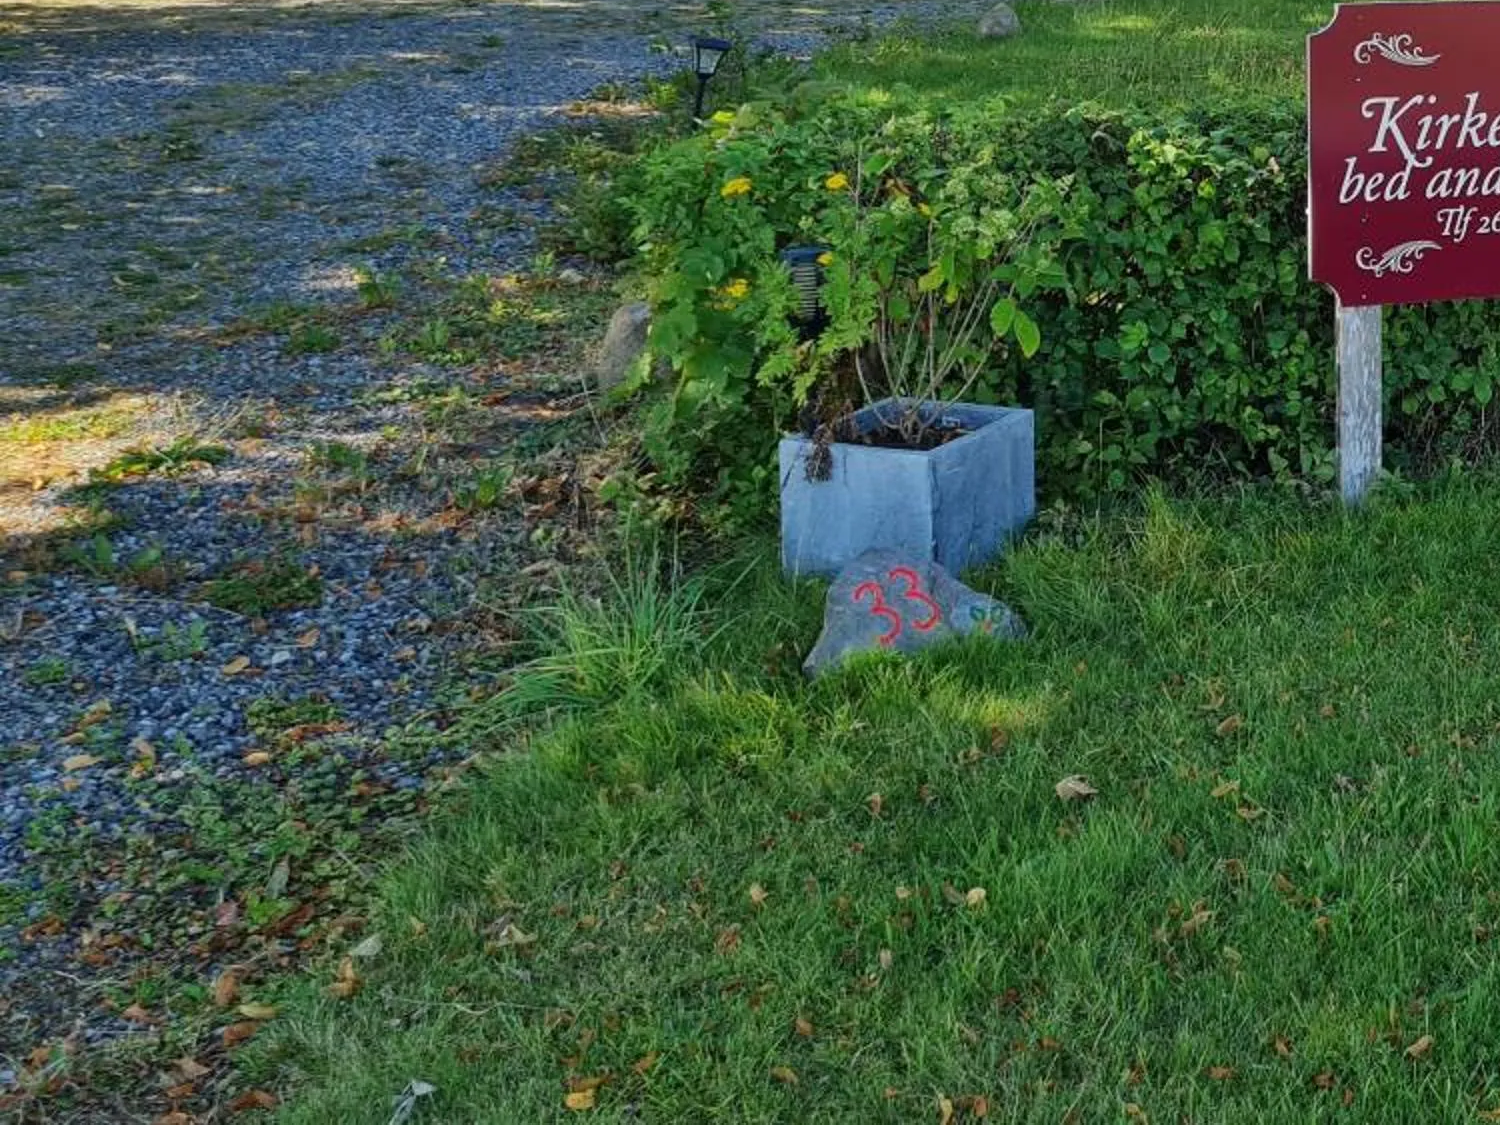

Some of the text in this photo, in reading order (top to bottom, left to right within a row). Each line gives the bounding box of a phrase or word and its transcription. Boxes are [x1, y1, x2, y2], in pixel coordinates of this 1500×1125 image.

[1339, 154, 1414, 204] bed
[1437, 205, 1478, 242] Tlf
[852, 566, 943, 647] 33
